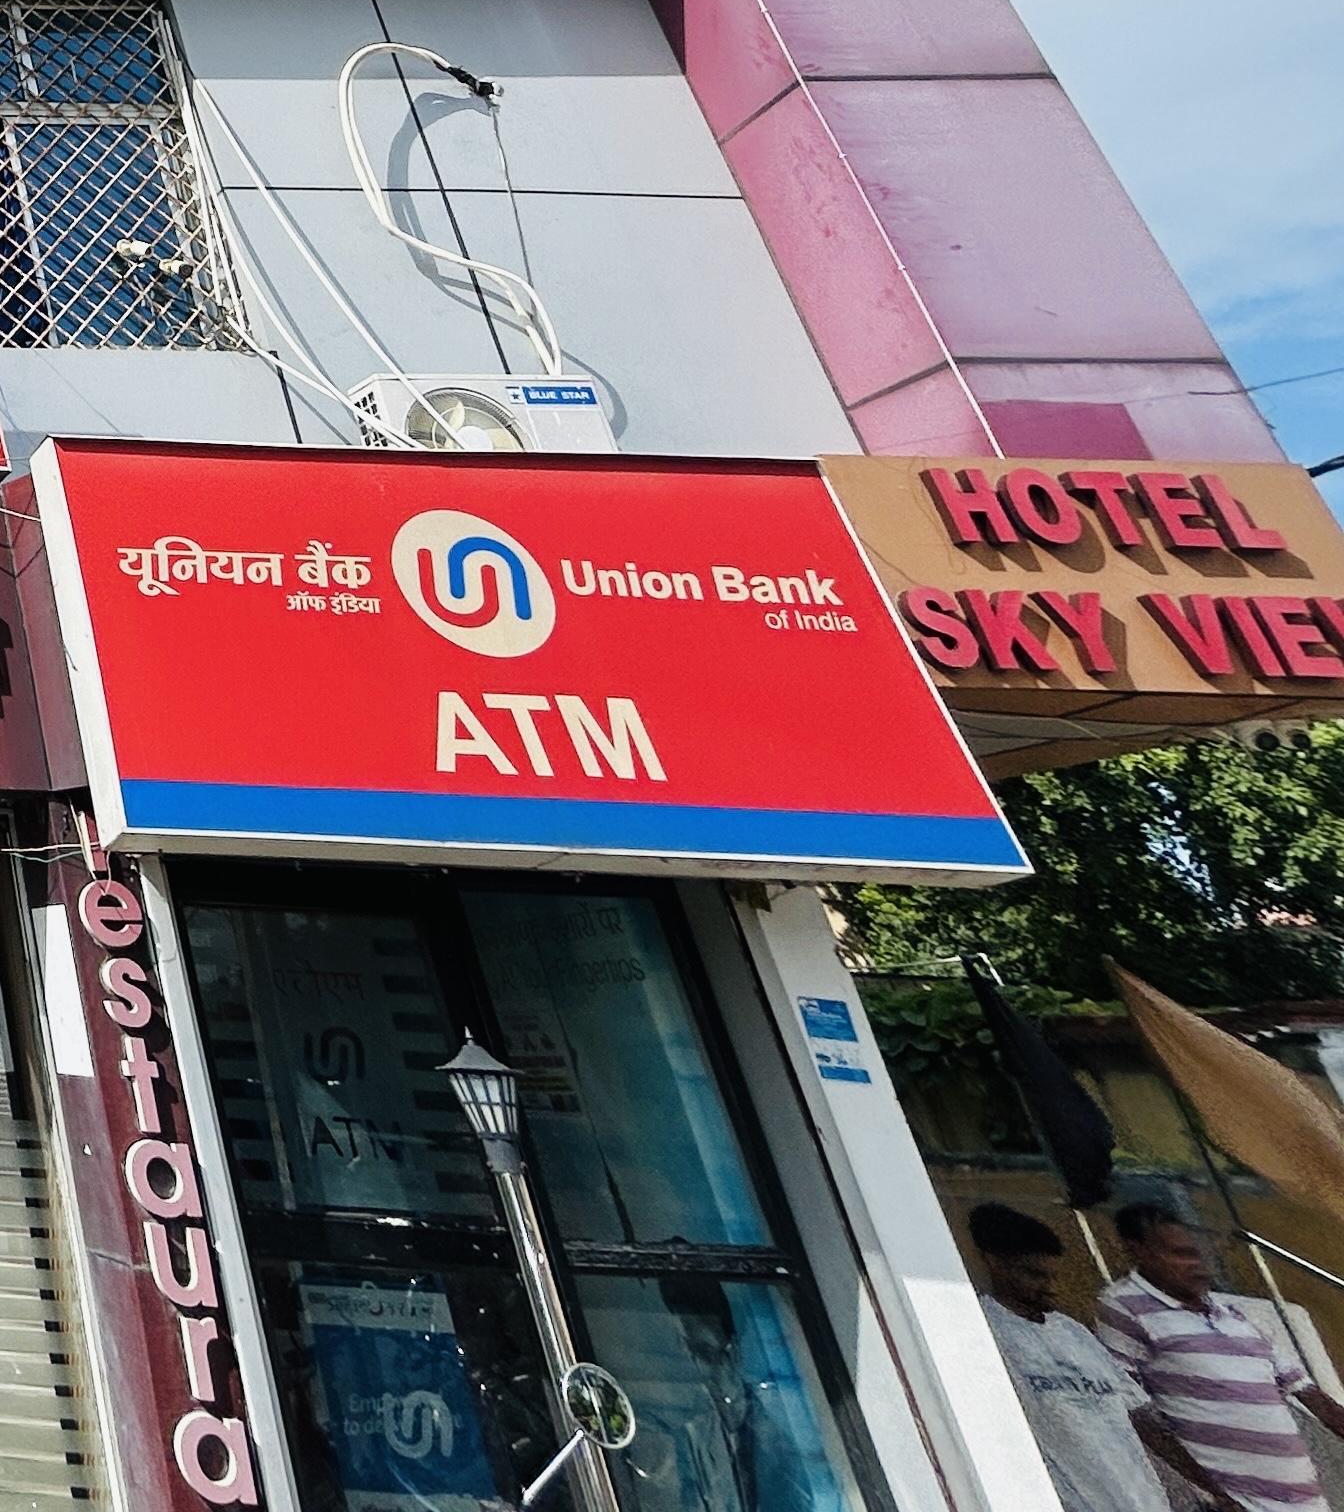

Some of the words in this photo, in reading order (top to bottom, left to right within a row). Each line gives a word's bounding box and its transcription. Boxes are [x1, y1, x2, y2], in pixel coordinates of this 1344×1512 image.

[528, 390, 558, 400] BLUE
[561, 391, 590, 400] STAR
[919, 467, 1288, 550] HOTEL
[116, 535, 284, 596] यूनियन
[294, 540, 372, 589] बैंक
[560, 558, 704, 601] Union
[712, 565, 844, 606] Bank
[285, 591, 325, 612] ऑफ
[330, 593, 381, 615] इंडिया
[764, 610, 790, 630] of
[794, 609, 858, 633] India
[900, 587, 1115, 673] SKY
[434, 690, 668, 782] ATM
